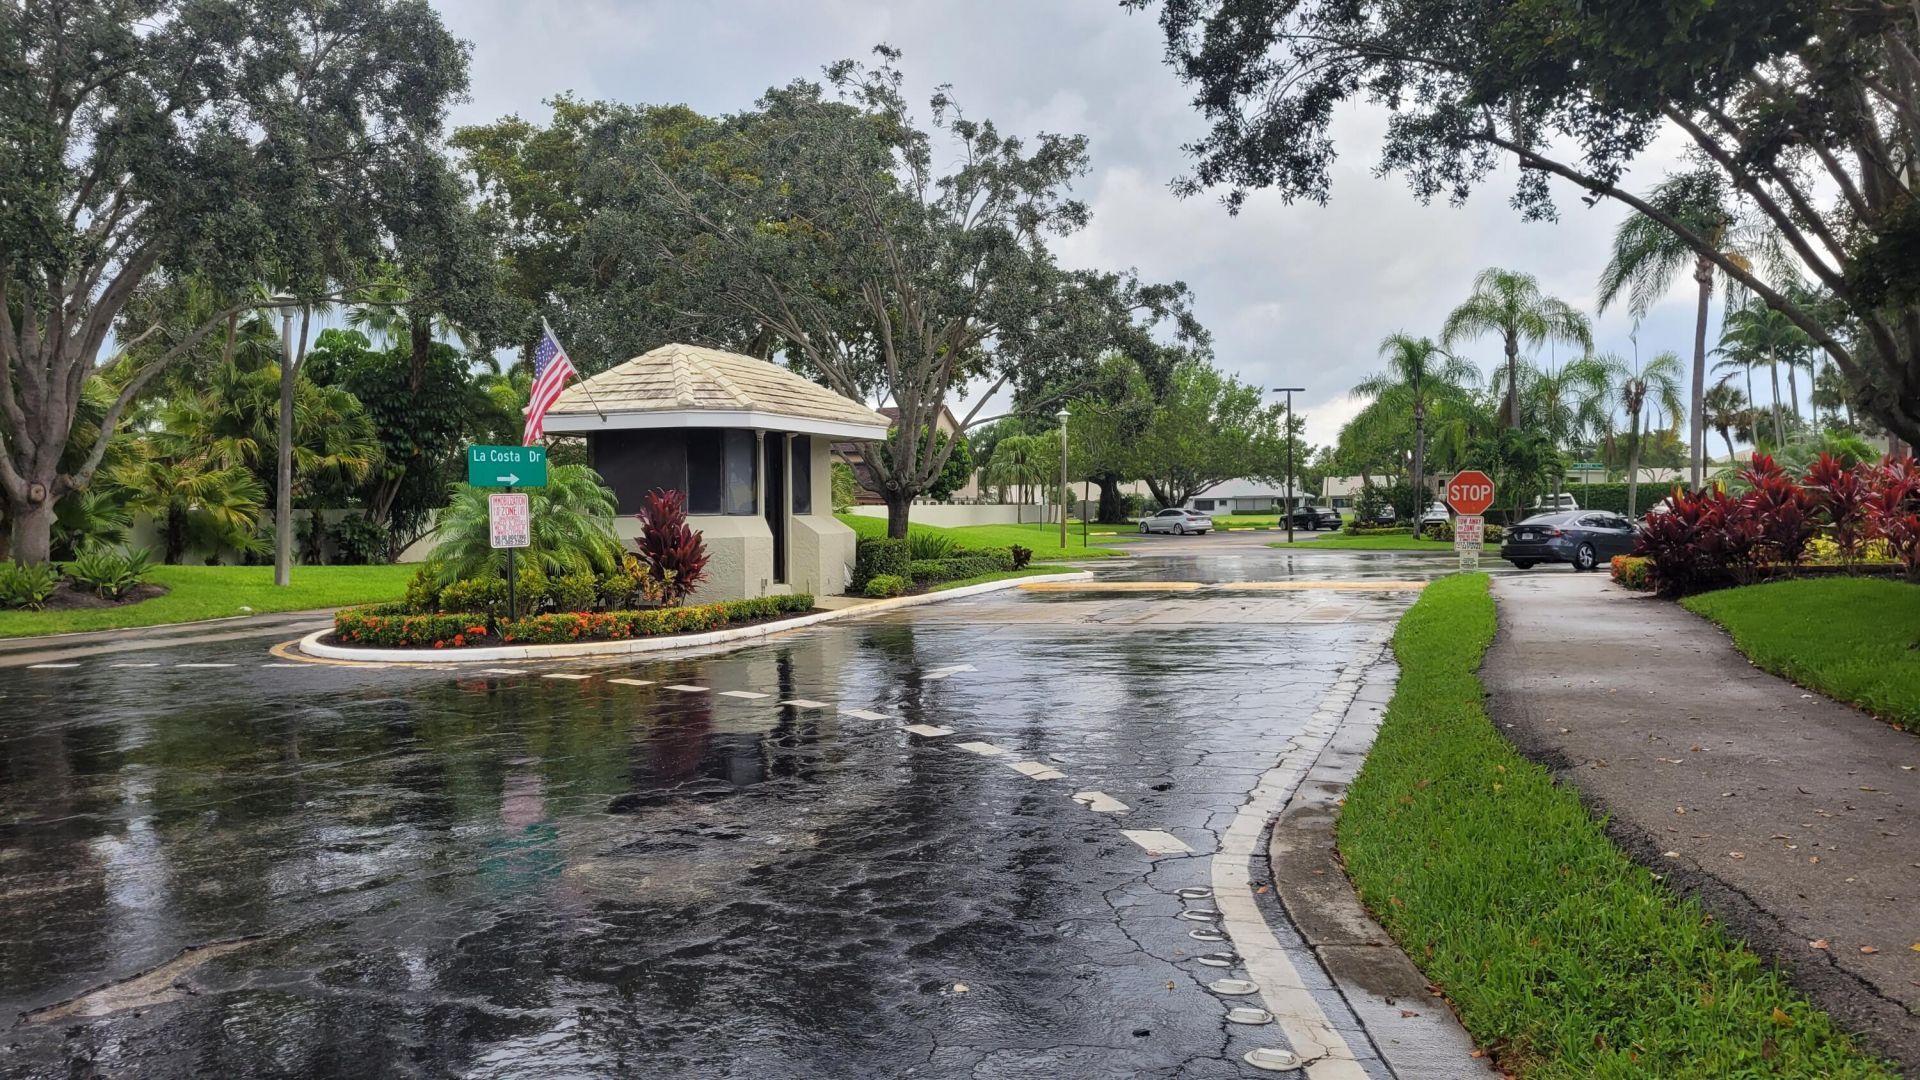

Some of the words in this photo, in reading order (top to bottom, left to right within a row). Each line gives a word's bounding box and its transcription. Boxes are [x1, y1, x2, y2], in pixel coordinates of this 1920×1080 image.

[473, 450, 486, 462] La
[490, 450, 520, 462] Costa
[529, 451, 541, 462] Dr
[1450, 484, 1490, 501] STOP
[501, 506, 517, 516] ZONE
